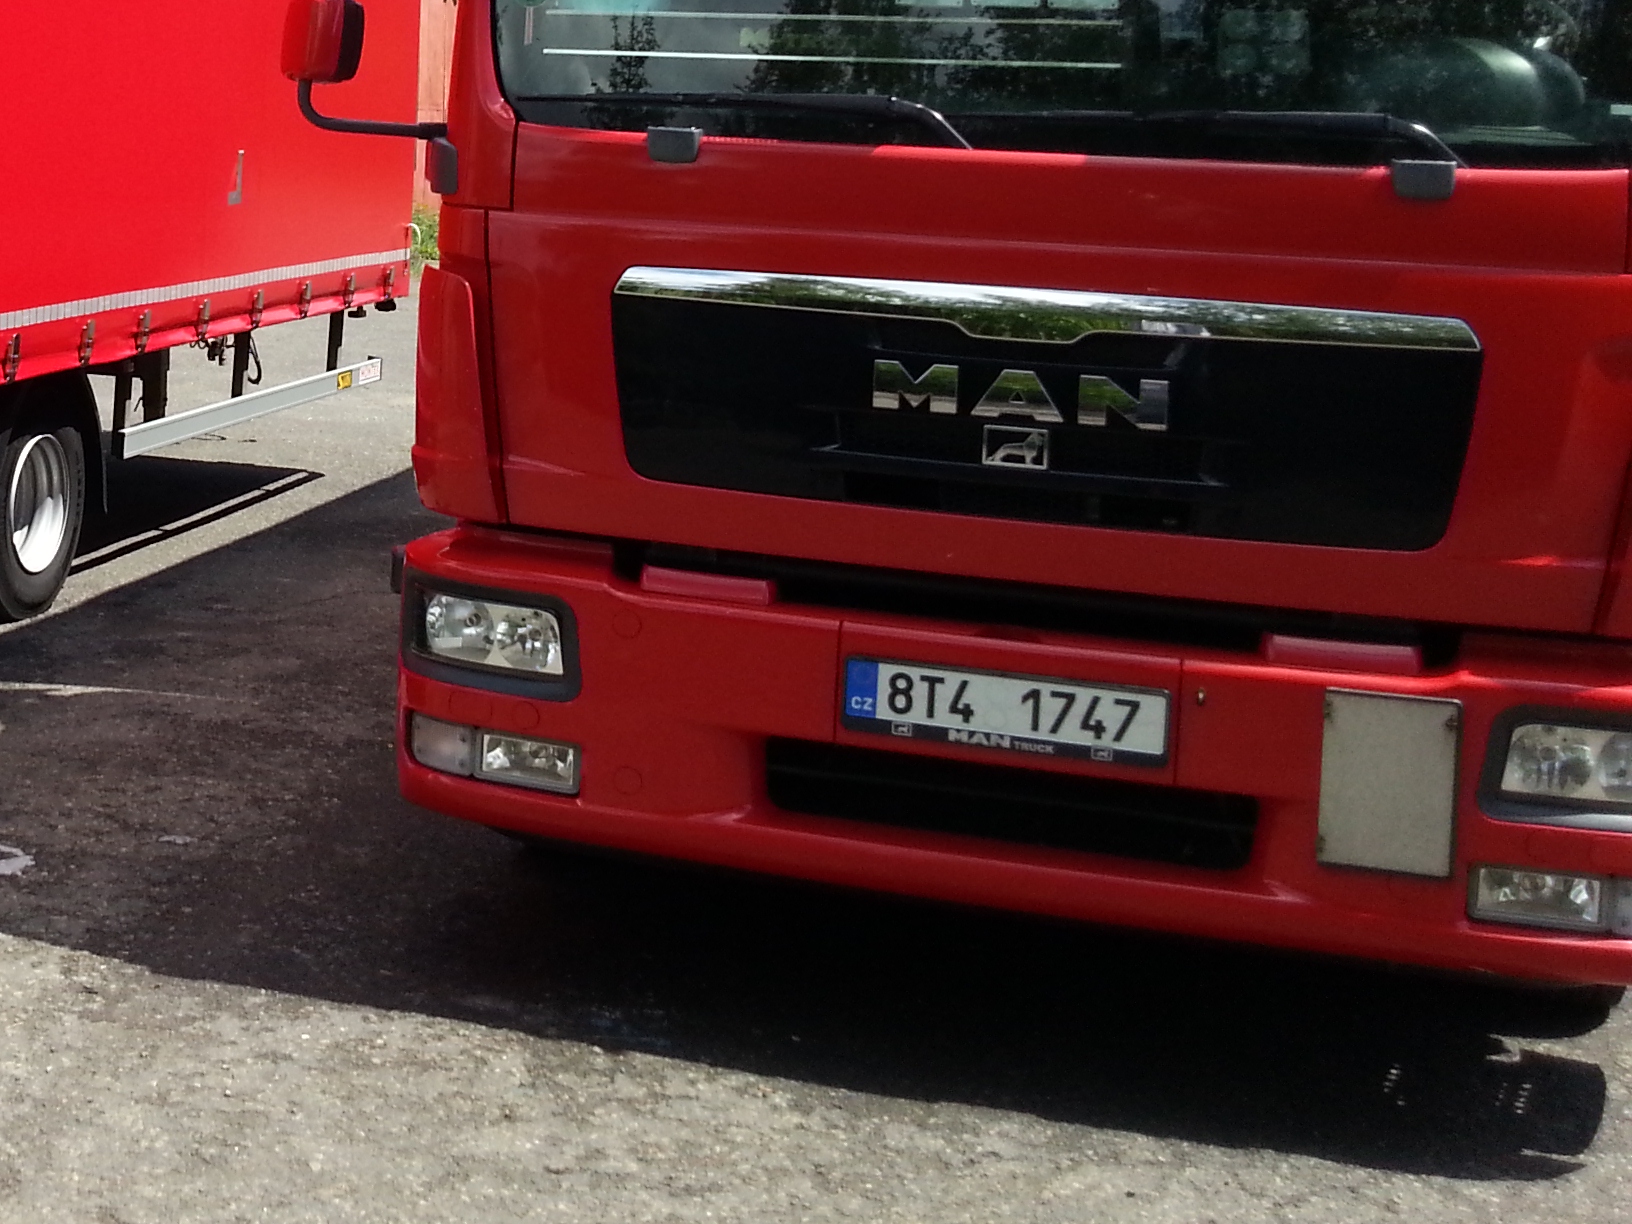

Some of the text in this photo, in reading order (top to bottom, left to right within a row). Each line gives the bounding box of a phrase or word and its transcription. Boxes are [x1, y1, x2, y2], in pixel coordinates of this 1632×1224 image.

[872, 358, 1169, 431] MAN
[850, 671, 1142, 743] CZ 8T4 1747
[947, 728, 1056, 756] MAN TRUCK
